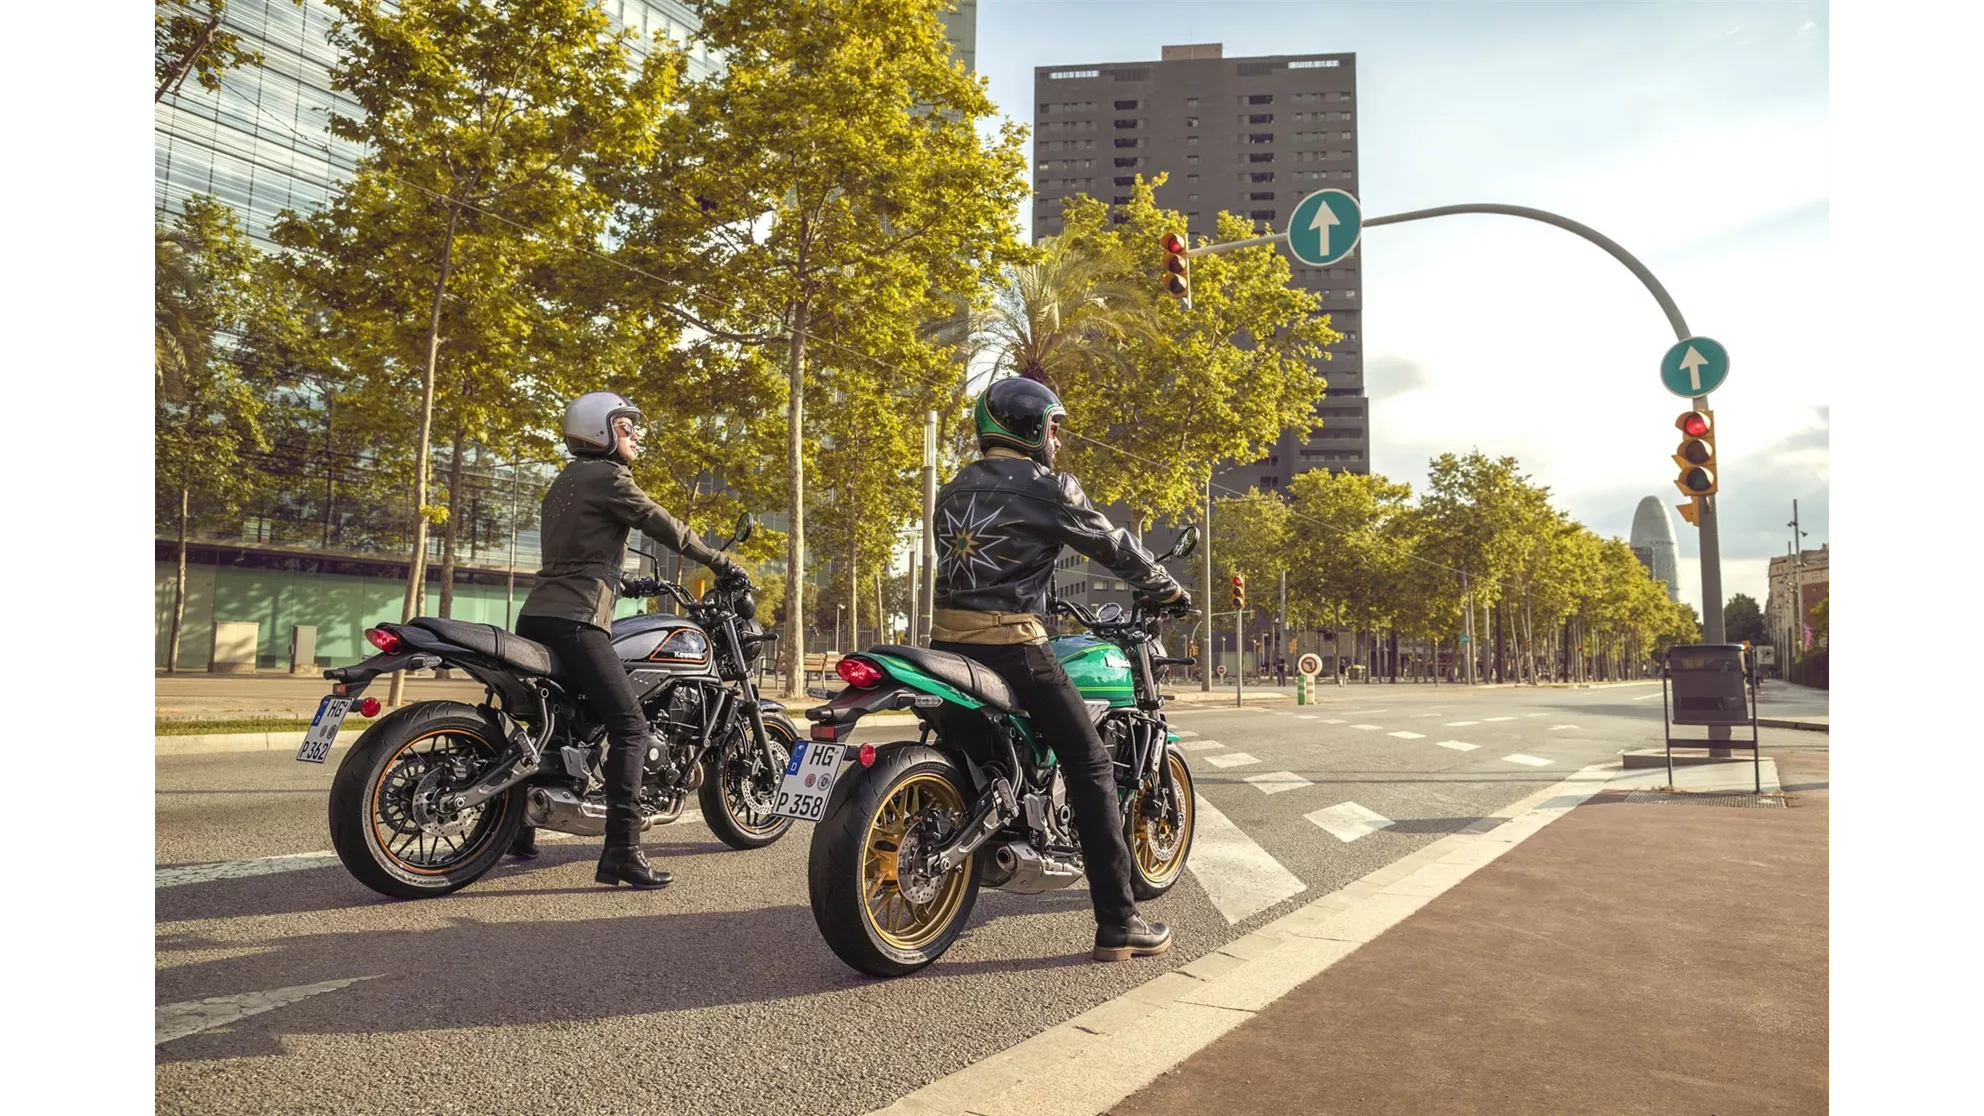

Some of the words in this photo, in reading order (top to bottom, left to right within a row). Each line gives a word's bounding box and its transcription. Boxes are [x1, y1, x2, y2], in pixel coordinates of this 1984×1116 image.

[327, 700, 345, 717] HG
[300, 741, 310, 758] P
[307, 742, 328, 760] 362
[810, 745, 835, 767] HG
[791, 762, 798, 772] D
[776, 792, 789, 812] P
[789, 794, 823, 818] 358
